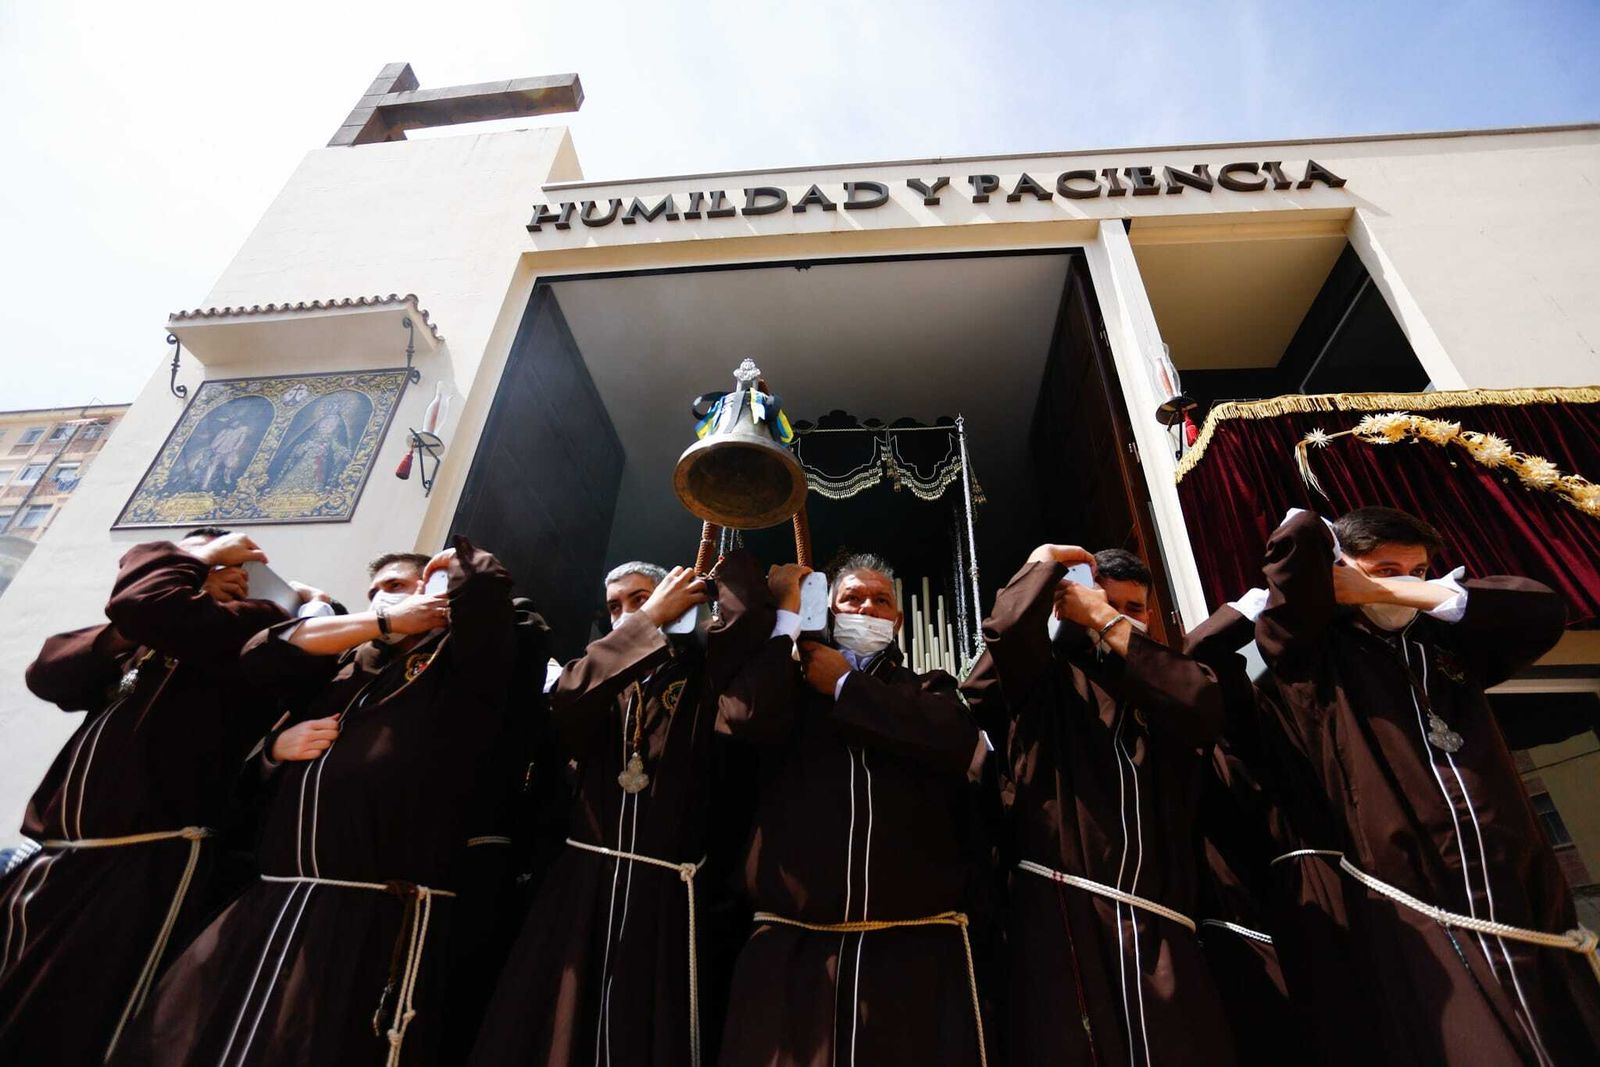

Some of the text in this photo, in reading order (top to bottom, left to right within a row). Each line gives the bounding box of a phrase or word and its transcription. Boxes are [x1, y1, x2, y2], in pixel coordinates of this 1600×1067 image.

[526, 159, 1347, 232] HUMILDAD Y PACIENCIA
